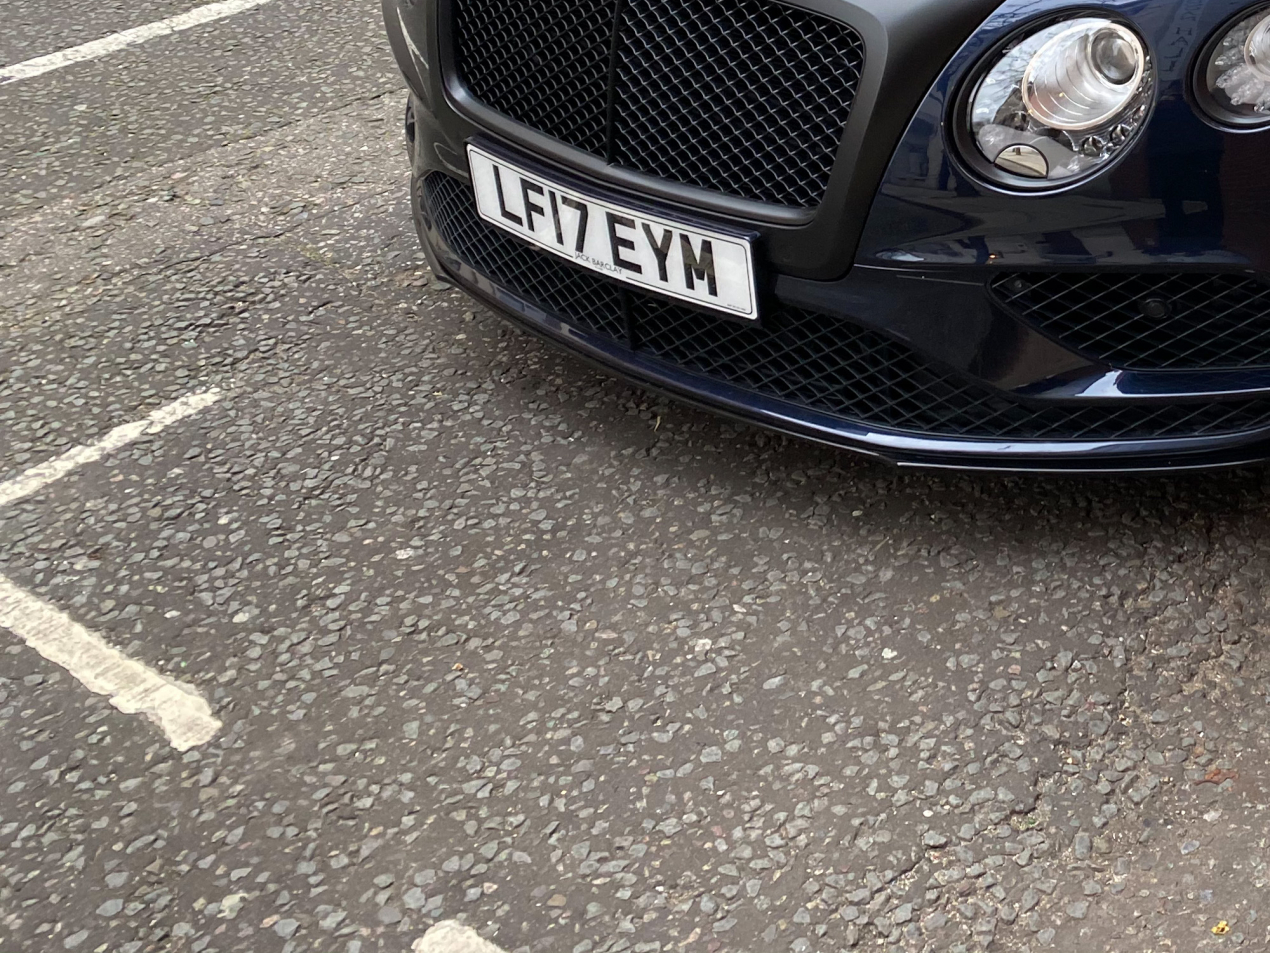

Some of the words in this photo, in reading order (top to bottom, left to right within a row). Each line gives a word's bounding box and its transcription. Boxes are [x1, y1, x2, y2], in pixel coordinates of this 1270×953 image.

[492, 164, 588, 253] LF17
[605, 211, 718, 297] EYM
[574, 251, 591, 264] JACK
[592, 258, 622, 275] BARCLAY
